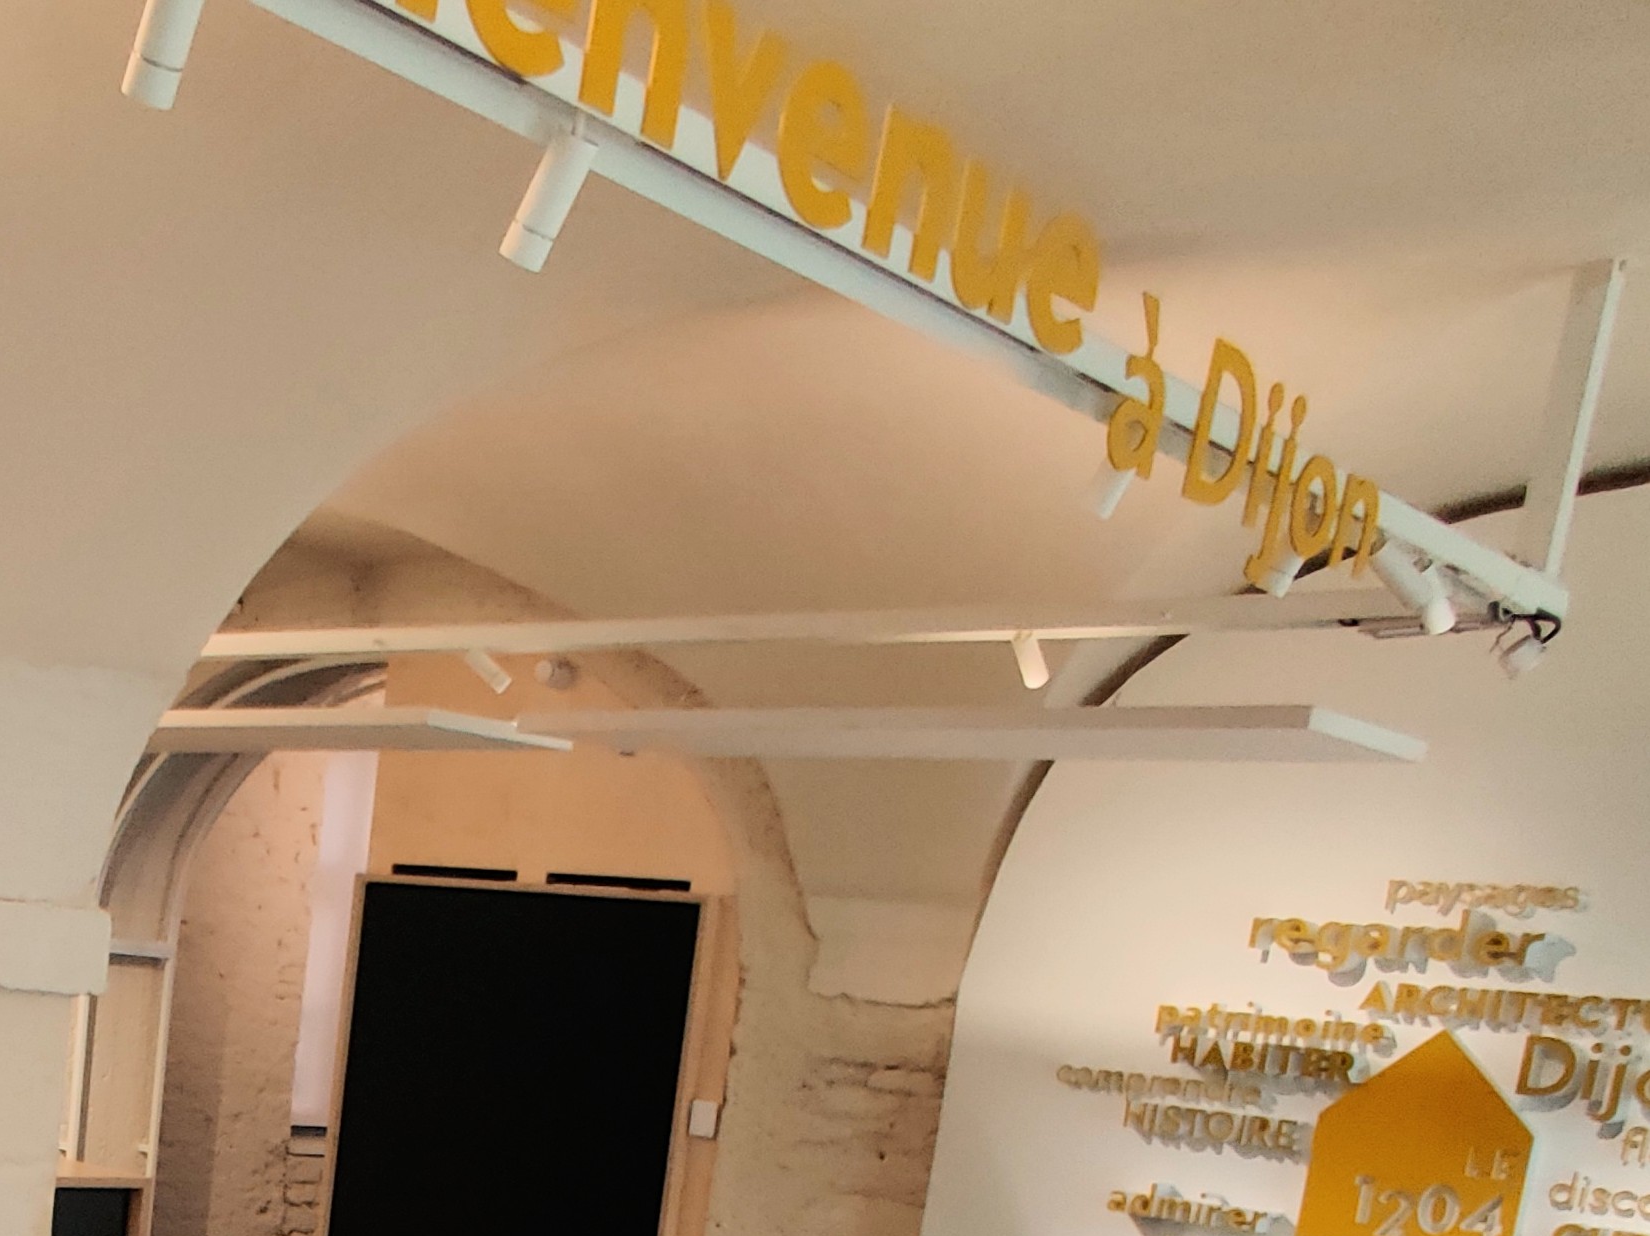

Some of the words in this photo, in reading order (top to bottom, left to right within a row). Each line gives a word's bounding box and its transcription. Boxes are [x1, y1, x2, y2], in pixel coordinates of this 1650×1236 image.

[1106, 291, 1165, 480] à
[1181, 337, 1380, 584] Dijon
[1248, 909, 1546, 970] regarder
[1155, 1001, 1385, 1046] patrimoine
[1170, 1033, 1354, 1082] HABITER
[1123, 1099, 1298, 1149] HISTOIRE
[1464, 1147, 1519, 1180] LE
[1107, 1183, 1267, 1232] admirer
